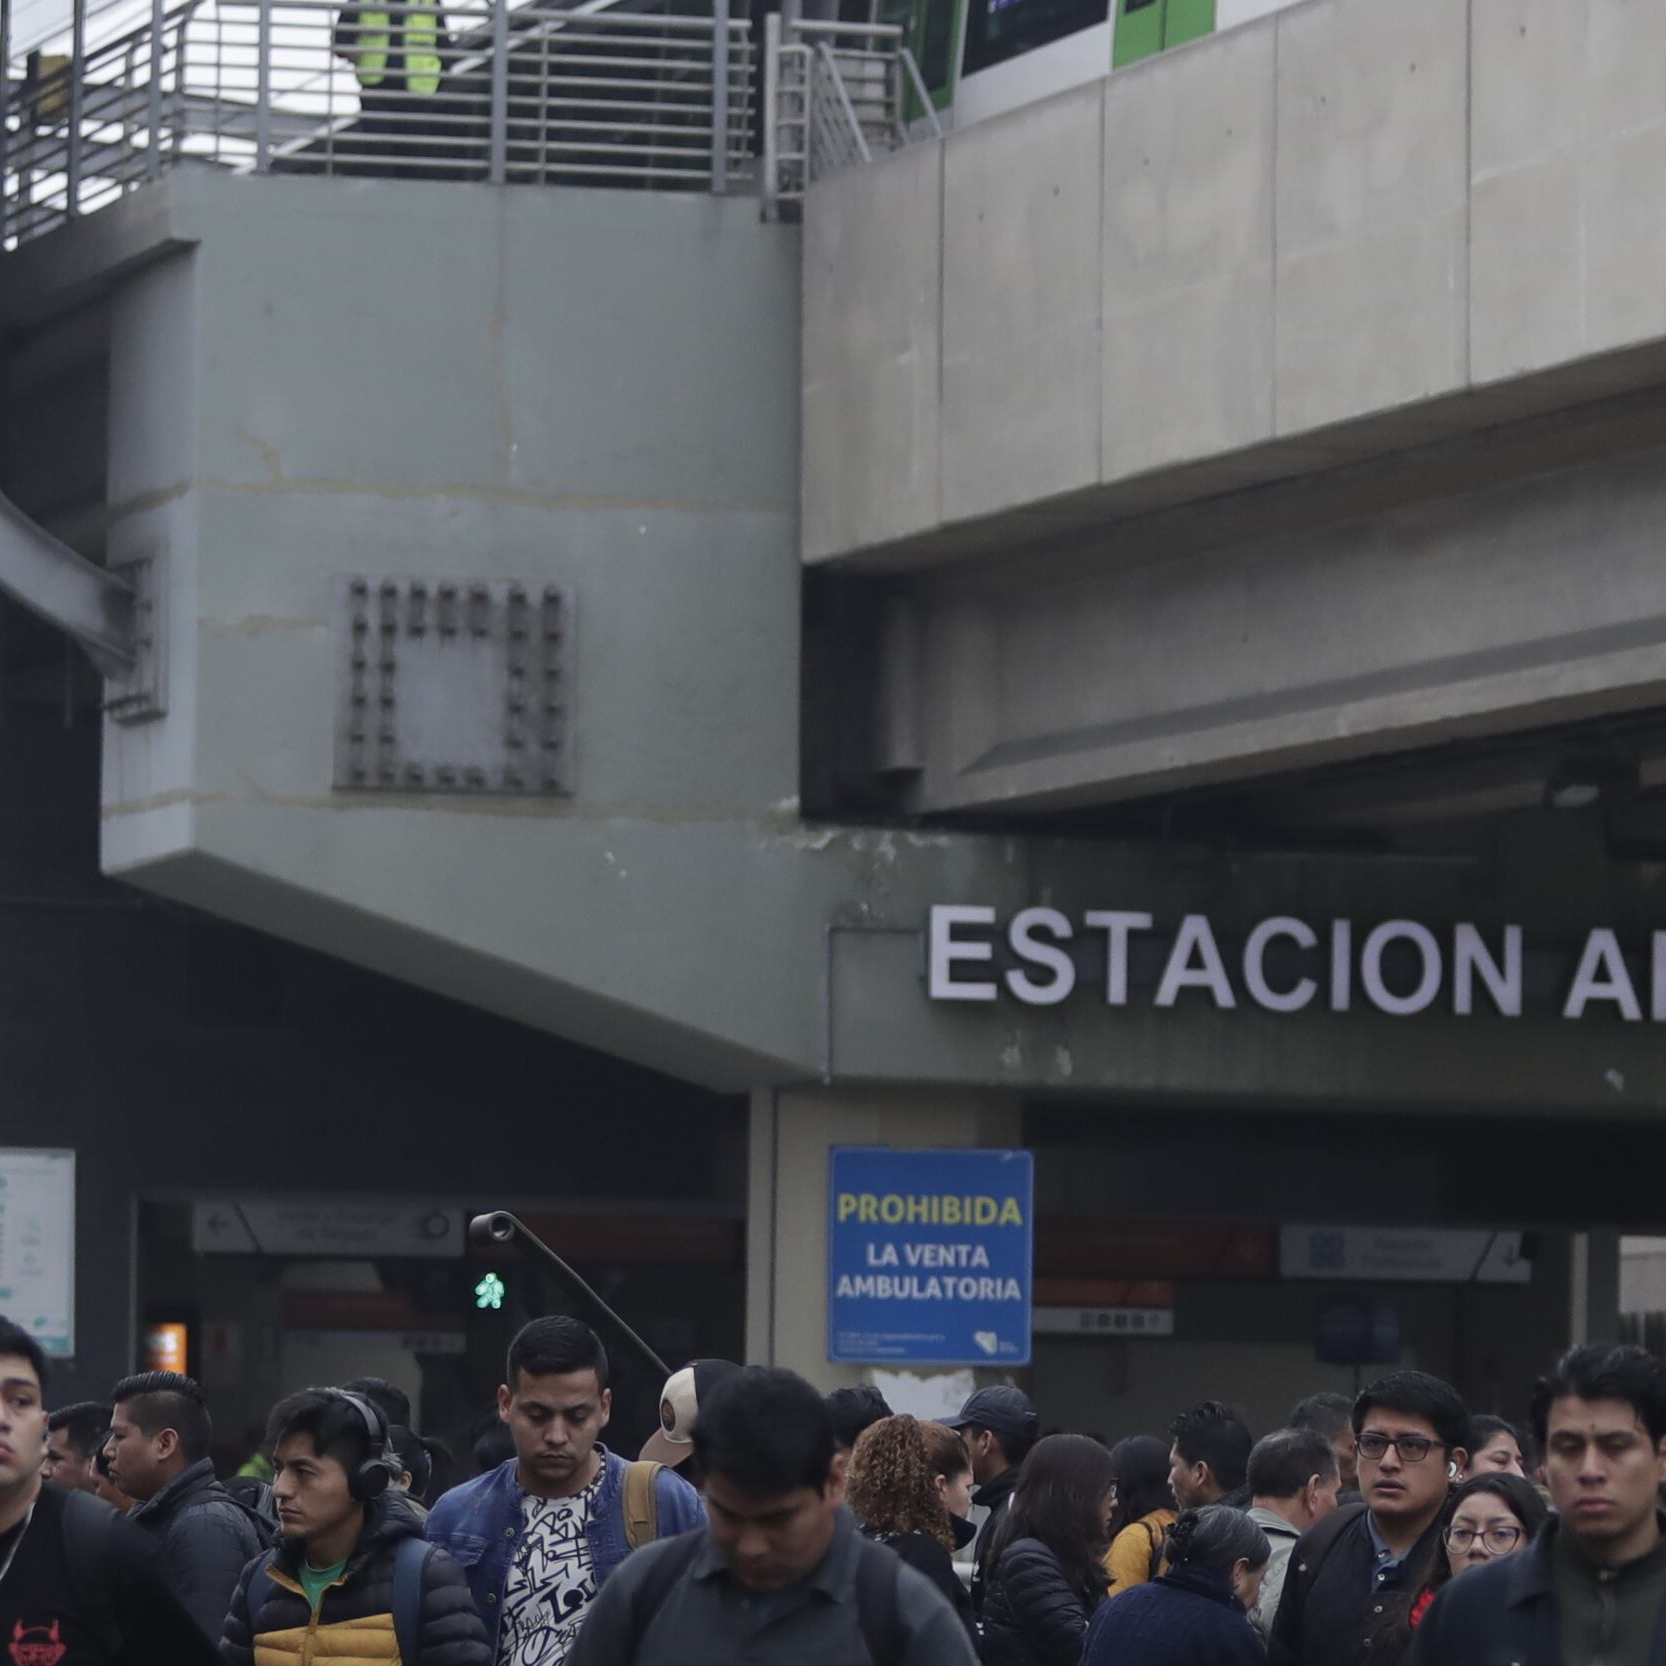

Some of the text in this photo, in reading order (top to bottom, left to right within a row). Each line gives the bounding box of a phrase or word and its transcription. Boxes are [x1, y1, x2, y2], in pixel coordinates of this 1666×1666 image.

[929, 904, 1524, 1019] ESTACION
[837, 1193, 1023, 1226] PROHIBIDA
[866, 1243, 990, 1268] LA VENTA
[836, 1275, 1022, 1301] AMBULATORIA
